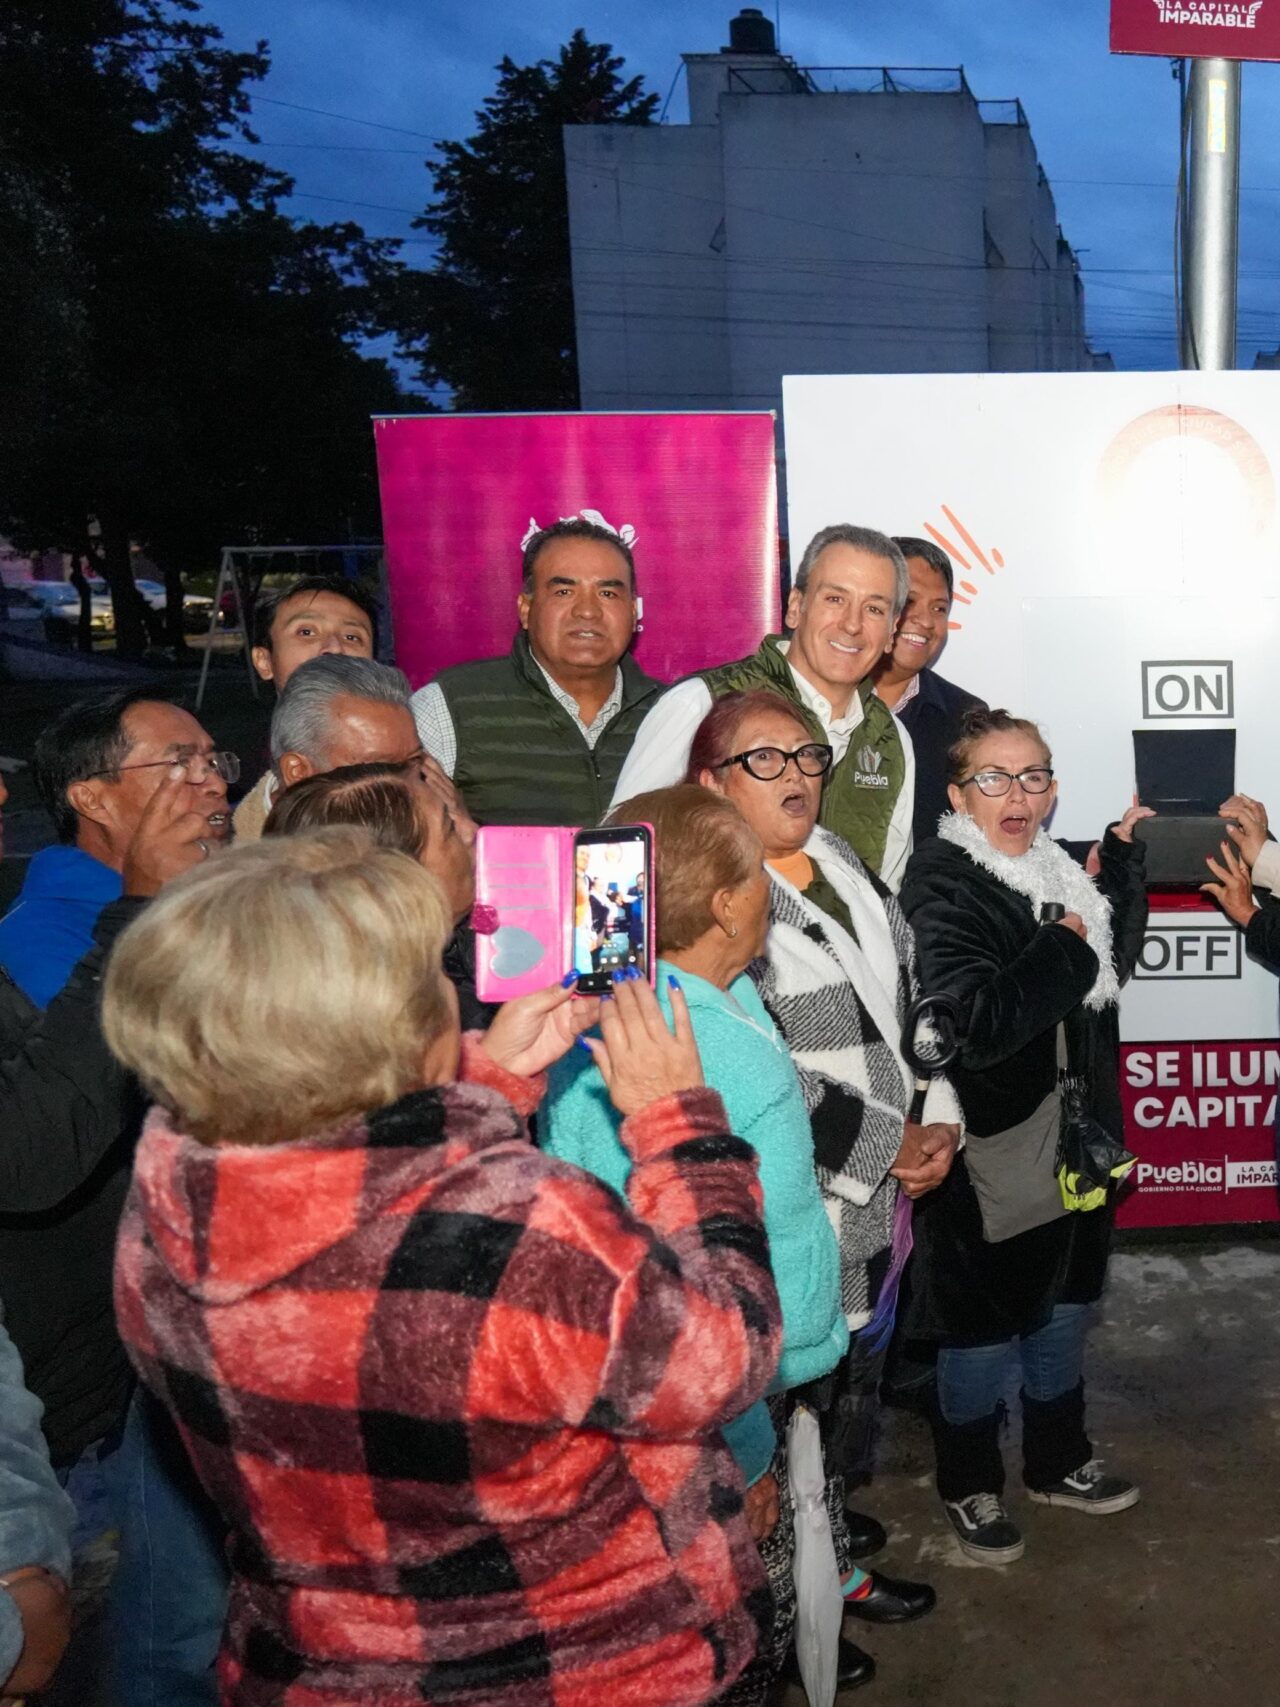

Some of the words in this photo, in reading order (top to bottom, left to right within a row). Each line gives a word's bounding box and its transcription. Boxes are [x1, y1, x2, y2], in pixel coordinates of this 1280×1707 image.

[1160, 9, 1256, 28] IMPARABLE
[1166, 1, 1182, 9] LA
[1188, 2, 1247, 13] CAPITAL
[1155, 674, 1224, 712] ON
[854, 771, 889, 786] Puebla
[1137, 935, 1232, 972] OFF
[1125, 1051, 1181, 1087] SE
[1137, 1161, 1223, 1184] Puebla
